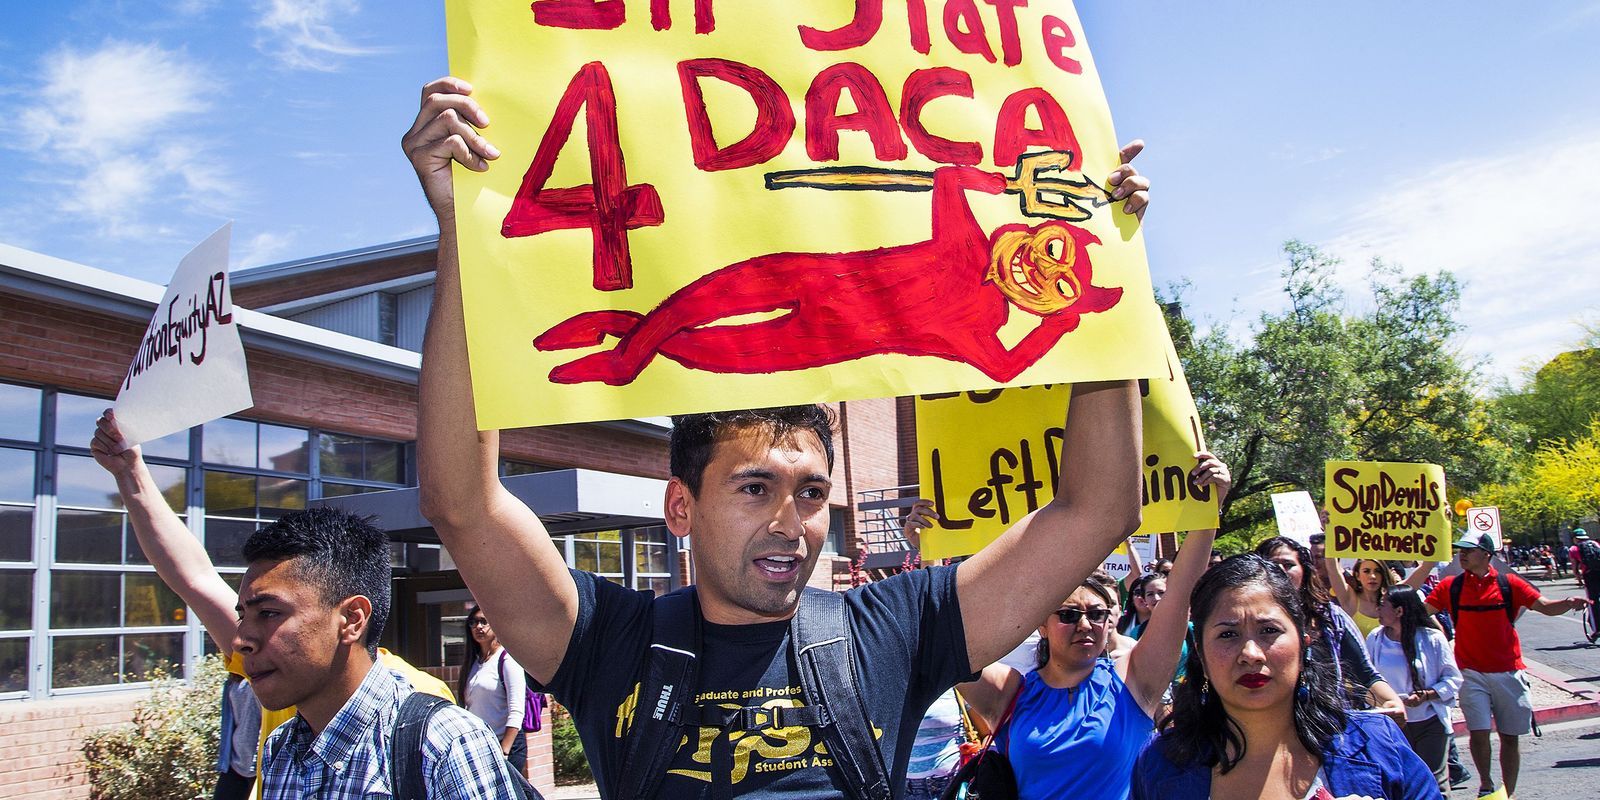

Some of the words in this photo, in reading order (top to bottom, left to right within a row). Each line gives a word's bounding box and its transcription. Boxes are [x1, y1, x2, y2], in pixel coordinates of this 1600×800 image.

[501, 61, 664, 290] 4
[677, 58, 1083, 171] DACA
[932, 447, 1043, 529] Left
[1332, 468, 1440, 514] SunDevils
[1334, 525, 1437, 556] Dreamers
[652, 684, 673, 720] THULE
[742, 687, 764, 698] and
[755, 759, 808, 773] Student
